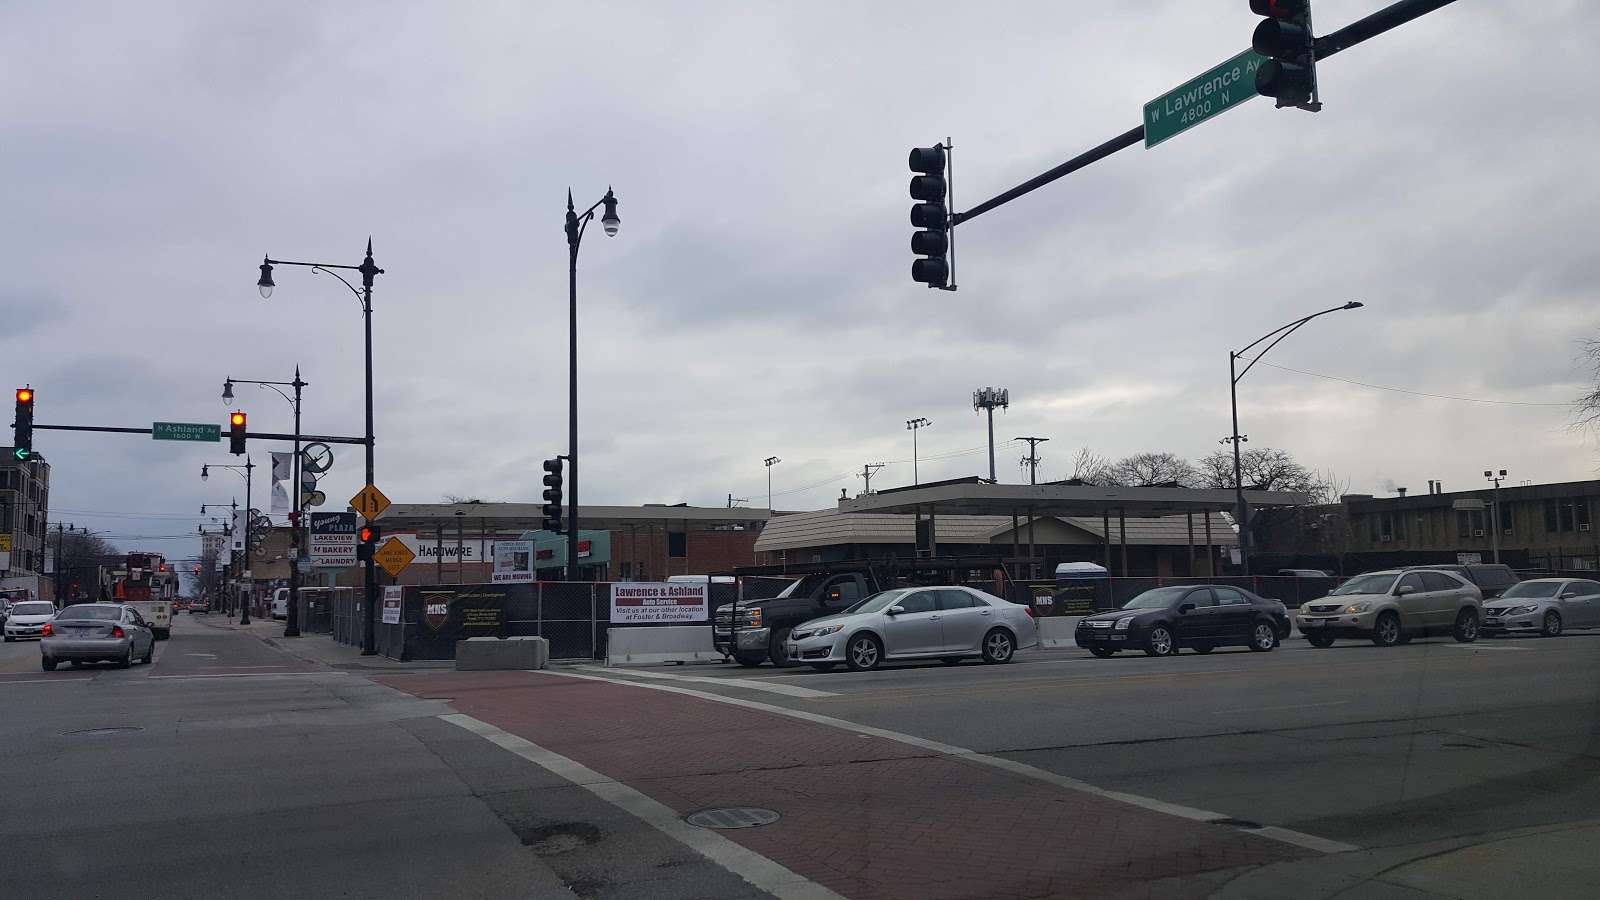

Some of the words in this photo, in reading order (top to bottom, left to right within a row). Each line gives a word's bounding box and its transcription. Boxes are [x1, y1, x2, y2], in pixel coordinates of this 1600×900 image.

[1152, 108, 1160, 122] W
[1165, 66, 1240, 116] Lawrence
[1246, 58, 1260, 74] Av
[1180, 100, 1211, 124] 4800
[1222, 90, 1230, 104] N
[166, 425, 204, 433] Ashland
[616, 587, 658, 596] Lawrence
[661, 587, 666, 596] &
[669, 586, 703, 596] Ashland
[1036, 596, 1052, 605] MNS
[427, 604, 447, 614] MNS
